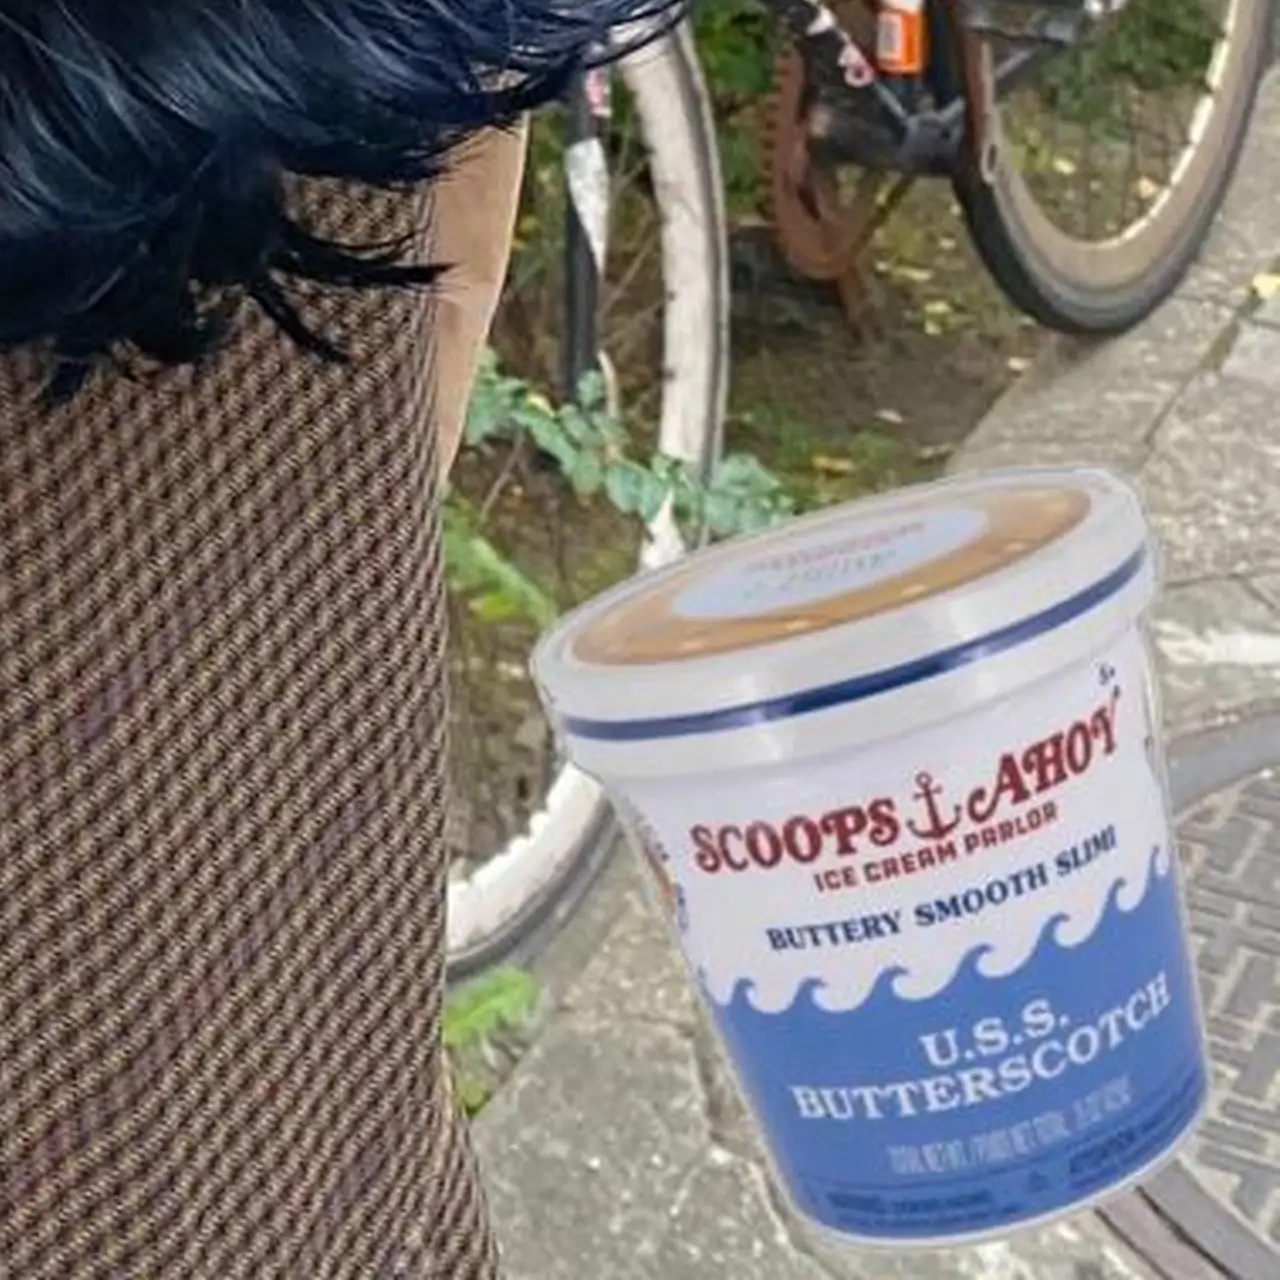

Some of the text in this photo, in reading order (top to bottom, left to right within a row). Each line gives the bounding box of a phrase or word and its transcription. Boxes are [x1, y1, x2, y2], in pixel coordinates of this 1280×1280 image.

[689, 685, 1120, 873] SCOOPS AHOY
[814, 801, 1058, 893] ICE CREAM PARLOR
[766, 911, 902, 951] BUTTERY
[913, 865, 1048, 927] SMOOTH
[791, 971, 1171, 1119] BUTTERSCOTCH
[920, 999, 1070, 1066] U.S.S.
